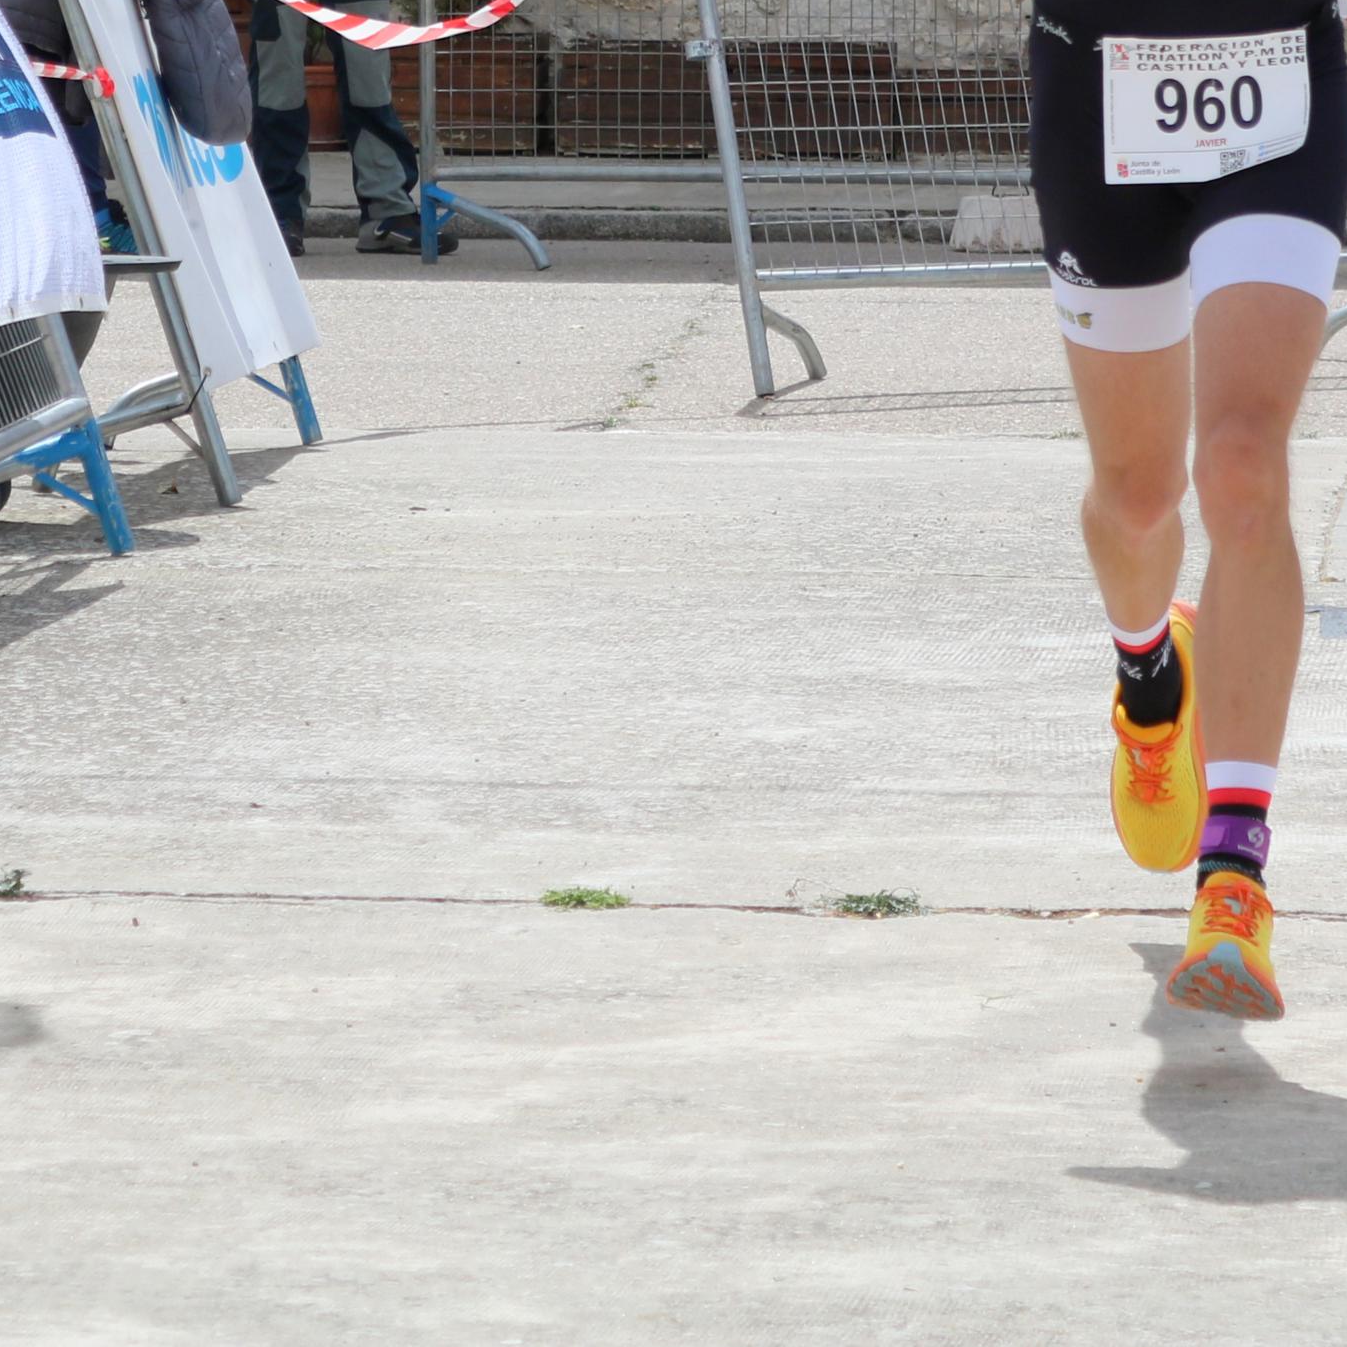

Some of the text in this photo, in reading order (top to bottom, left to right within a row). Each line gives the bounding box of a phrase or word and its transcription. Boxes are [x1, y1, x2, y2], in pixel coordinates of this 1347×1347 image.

[1136, 35, 1305, 52] FEDERACION DE
[1137, 52, 1222, 62] TRIATLON
[1228, 51, 1238, 59] Y
[1282, 45, 1305, 55] DE
[1136, 55, 1305, 72] CASTILLA Y LEON
[1153, 74, 1264, 134] 960
[1195, 138, 1227, 148] JAVIER
